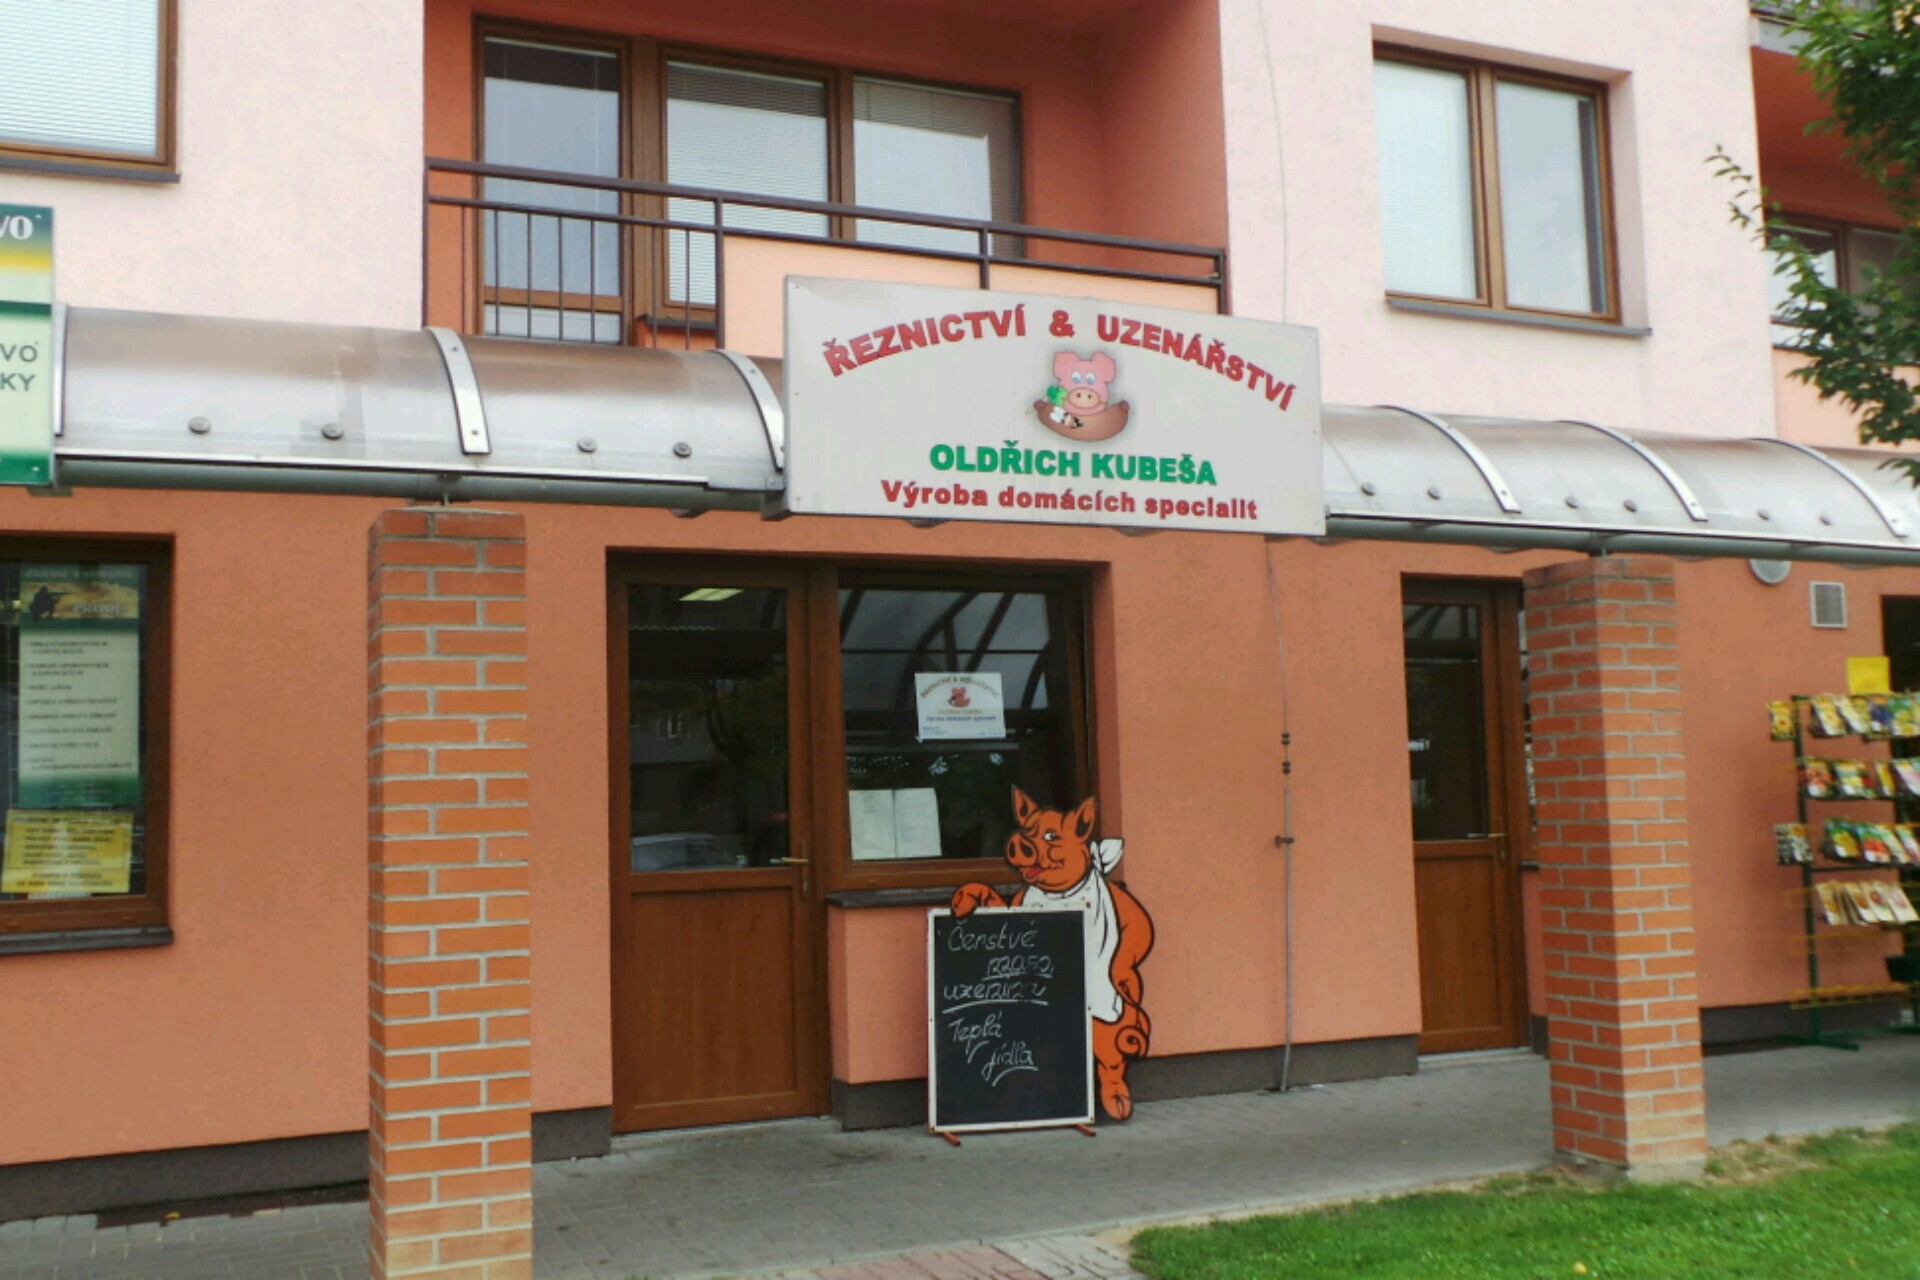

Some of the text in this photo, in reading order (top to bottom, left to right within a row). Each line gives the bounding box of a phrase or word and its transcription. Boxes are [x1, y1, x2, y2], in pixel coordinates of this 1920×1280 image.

[822, 303, 1296, 412] ŘEZNICTVÍ & UZENÁŘSTVÍ
[929, 440, 1217, 486] OLDŘICH KUBEŠA
[880, 479, 1258, 521] Výroba domácích specialit
[947, 919, 1038, 952] Čerstvé
[949, 1011, 1003, 1056] Teplá
[981, 1043, 1035, 1082] jídla
